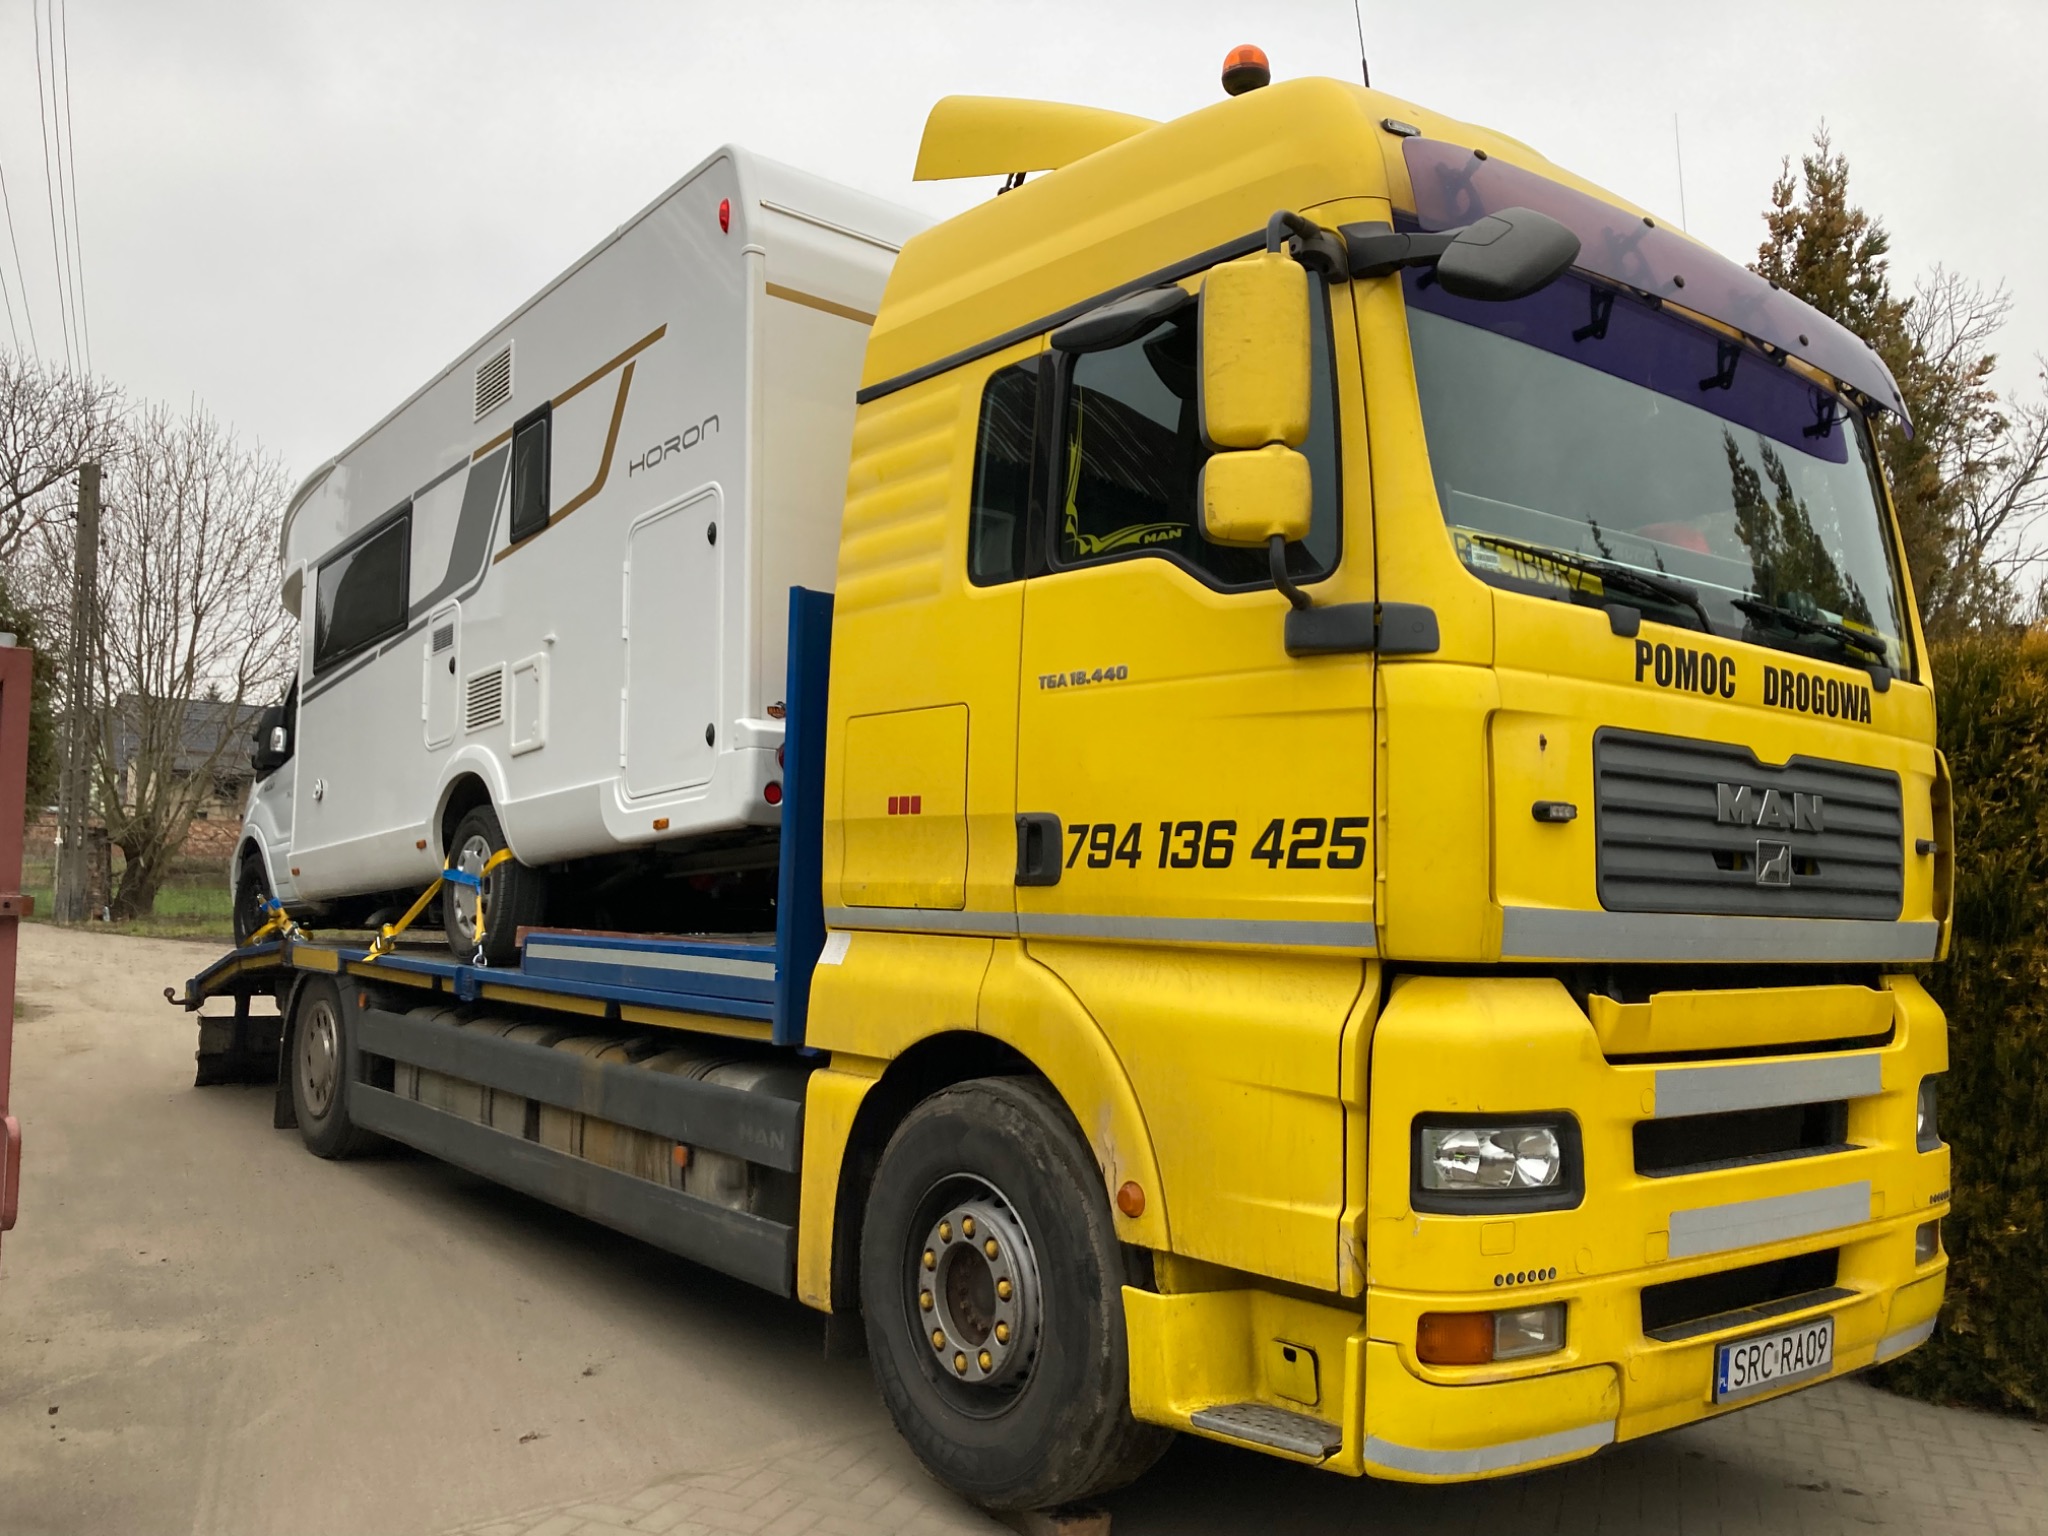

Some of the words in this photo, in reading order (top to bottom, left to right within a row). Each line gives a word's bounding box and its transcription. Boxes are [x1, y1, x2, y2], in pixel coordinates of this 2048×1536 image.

[629, 414, 719, 478] HORON
[1144, 528, 1182, 544] MAN
[1070, 665, 1129, 687] 18.440
[1635, 638, 1737, 699] POMOC
[1763, 664, 1873, 725] DROGOWA
[1717, 782, 1824, 833] MAN
[1065, 822, 1142, 869] 794
[1158, 820, 1238, 869] 136
[1250, 816, 1370, 870] 425
[738, 1123, 785, 1151] MAN
[1733, 1341, 1775, 1387] SRC
[1780, 1326, 1828, 1375] RA09
